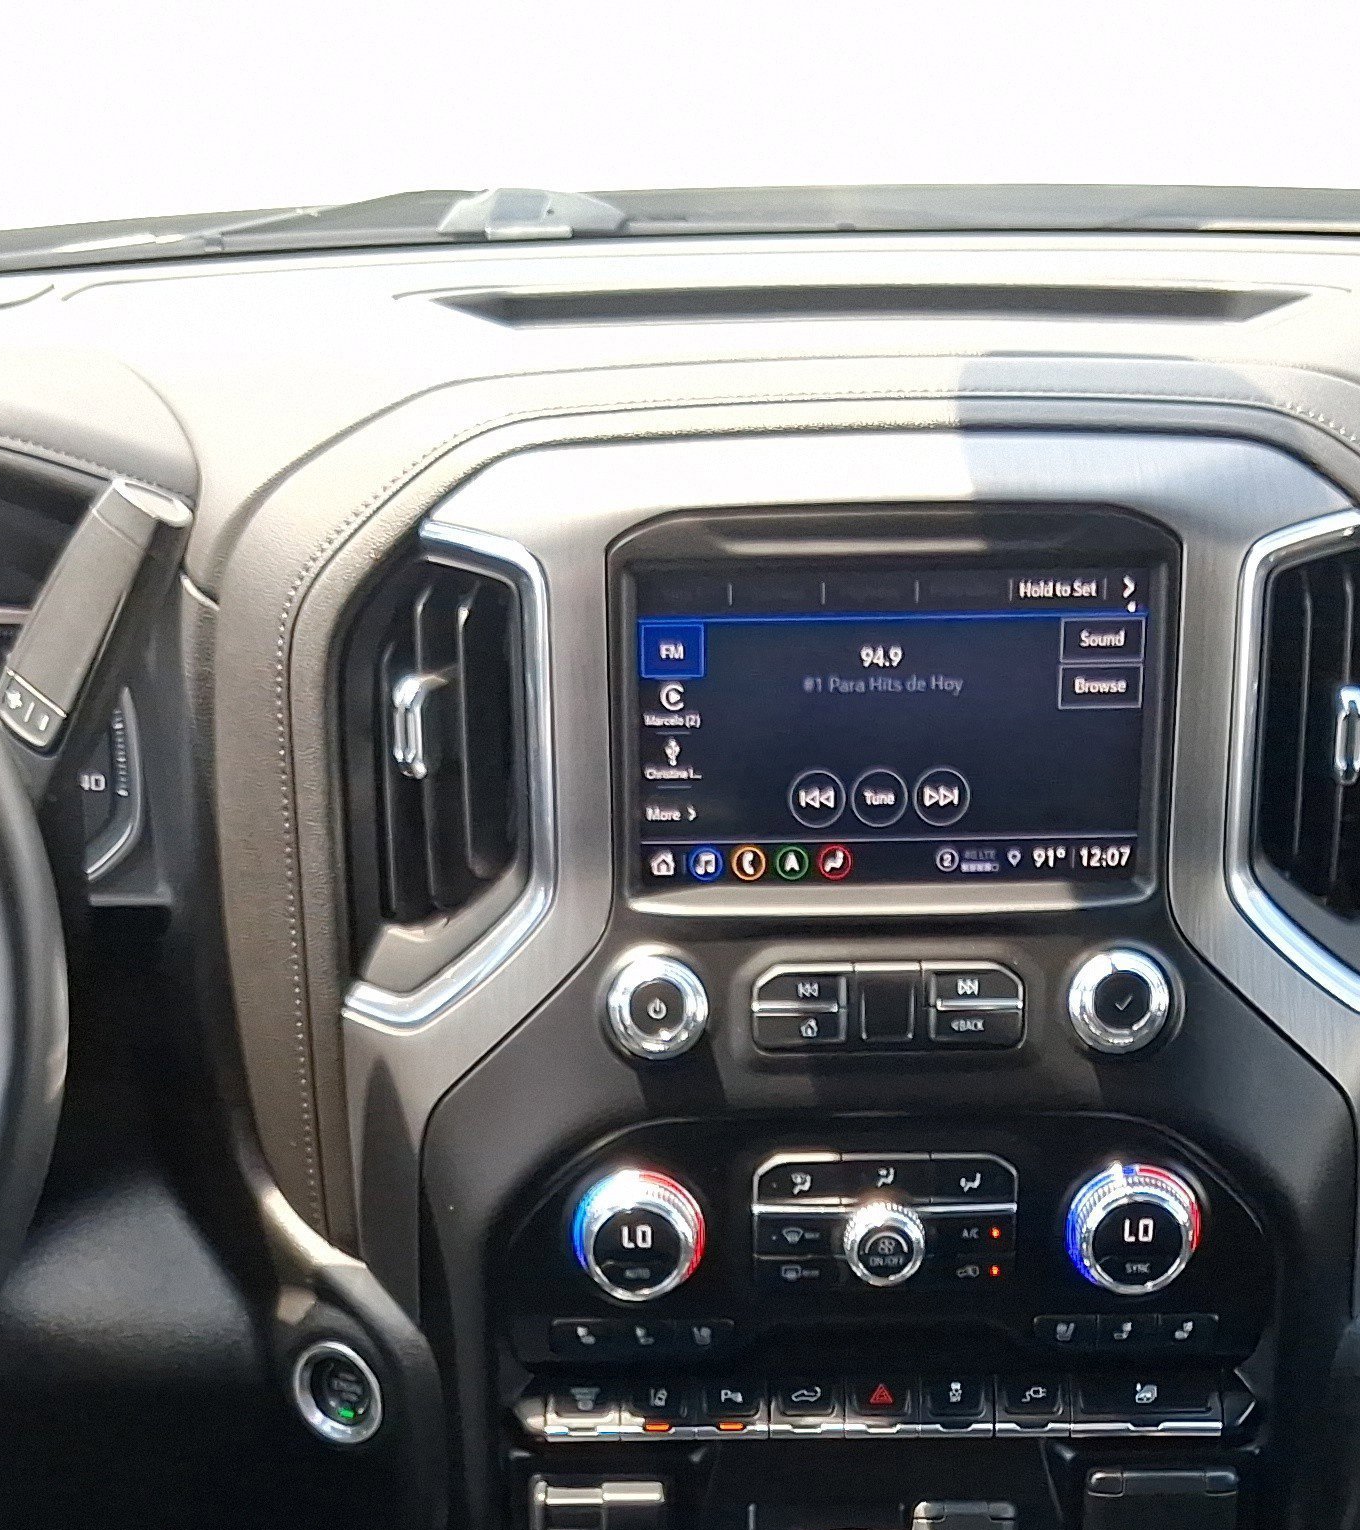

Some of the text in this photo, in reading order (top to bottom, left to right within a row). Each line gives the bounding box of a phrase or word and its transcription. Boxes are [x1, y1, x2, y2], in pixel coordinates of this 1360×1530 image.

[1019, 579, 1097, 598] Hold to Set
[1080, 629, 1125, 647] Sound
[659, 642, 685, 660] FM
[860, 645, 903, 668] 94.9
[829, 675, 865, 692] Para
[869, 676, 902, 692] Hits
[906, 674, 927, 692] de
[930, 674, 964, 696] Hoy
[1074, 677, 1127, 694] Browse
[863, 790, 895, 805] Tune
[645, 806, 681, 821] More
[1033, 847, 1066, 868] 91°
[1080, 846, 1131, 867] 12:07
[622, 1225, 652, 1248] LO
[1124, 1218, 1154, 1242] LO
